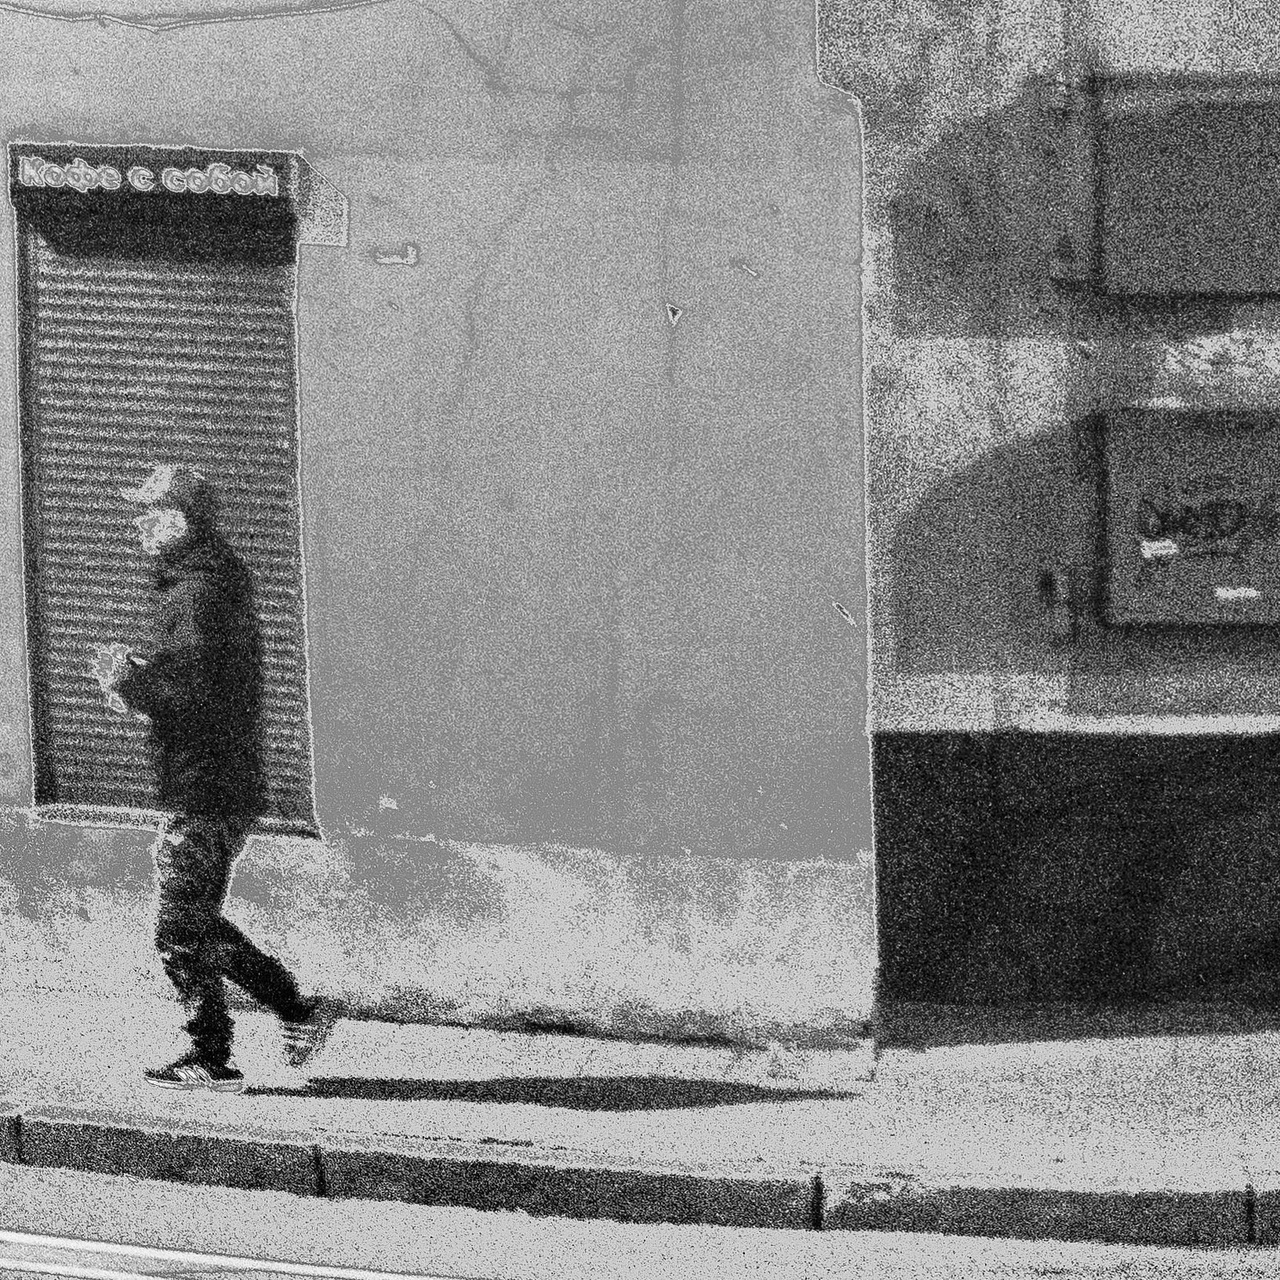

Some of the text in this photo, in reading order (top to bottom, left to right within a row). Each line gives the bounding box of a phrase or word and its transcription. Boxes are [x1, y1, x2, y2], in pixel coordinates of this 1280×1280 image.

[19, 156, 279, 196] Кофе с собой
